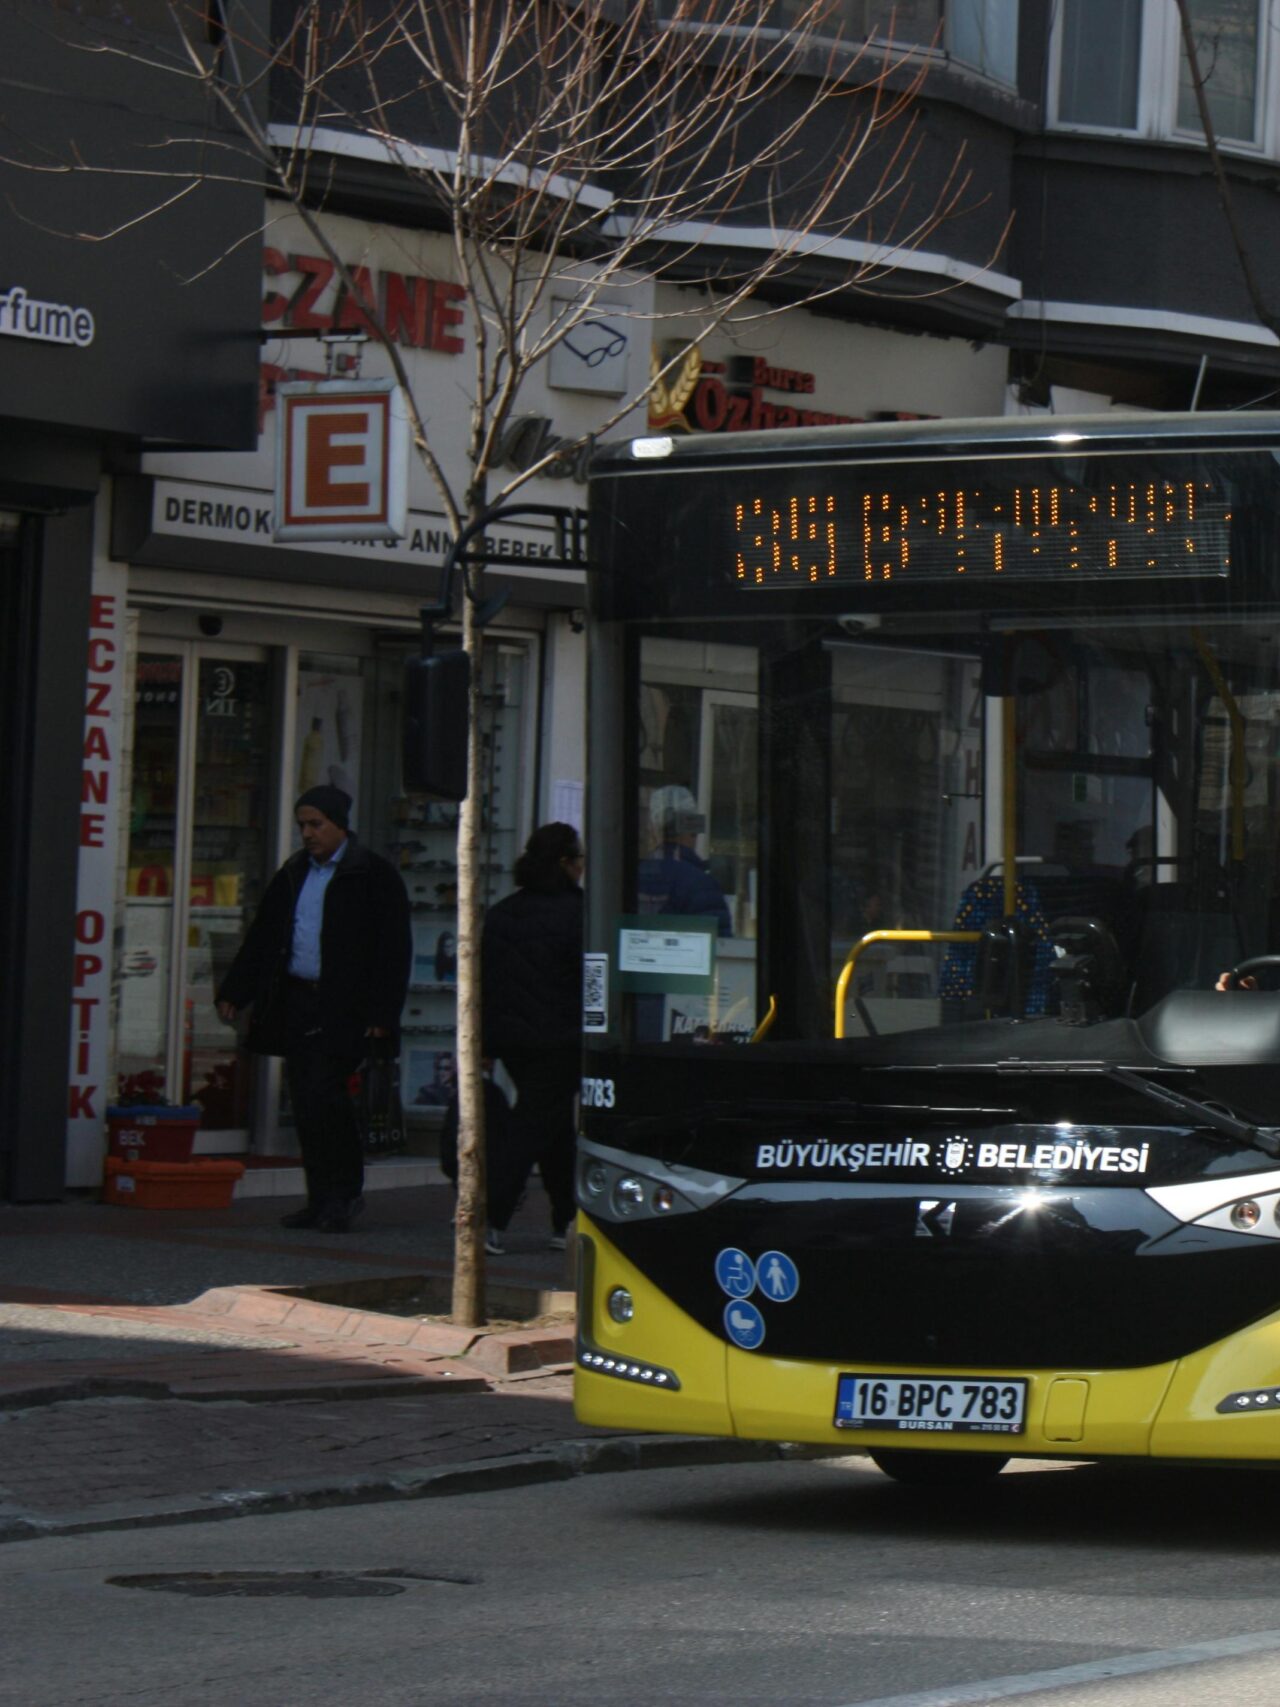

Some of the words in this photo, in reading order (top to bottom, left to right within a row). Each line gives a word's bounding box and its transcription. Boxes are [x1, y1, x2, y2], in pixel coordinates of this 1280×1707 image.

[0, 290, 92, 344] rfume
[261, 247, 466, 355] CZANE
[753, 356, 814, 393] Bursa
[306, 413, 370, 507] E
[81, 596, 116, 848] ECZANE
[68, 910, 104, 1119] OPTİK
[756, 1137, 930, 1173] BÜYÜKŞEHİR
[976, 1140, 1150, 1174] BELEDİYESİ
[859, 1382, 888, 1416] 16
[897, 1383, 954, 1418] BPC
[961, 1385, 1018, 1420] 783
[897, 1420, 954, 1431] BURSAN
